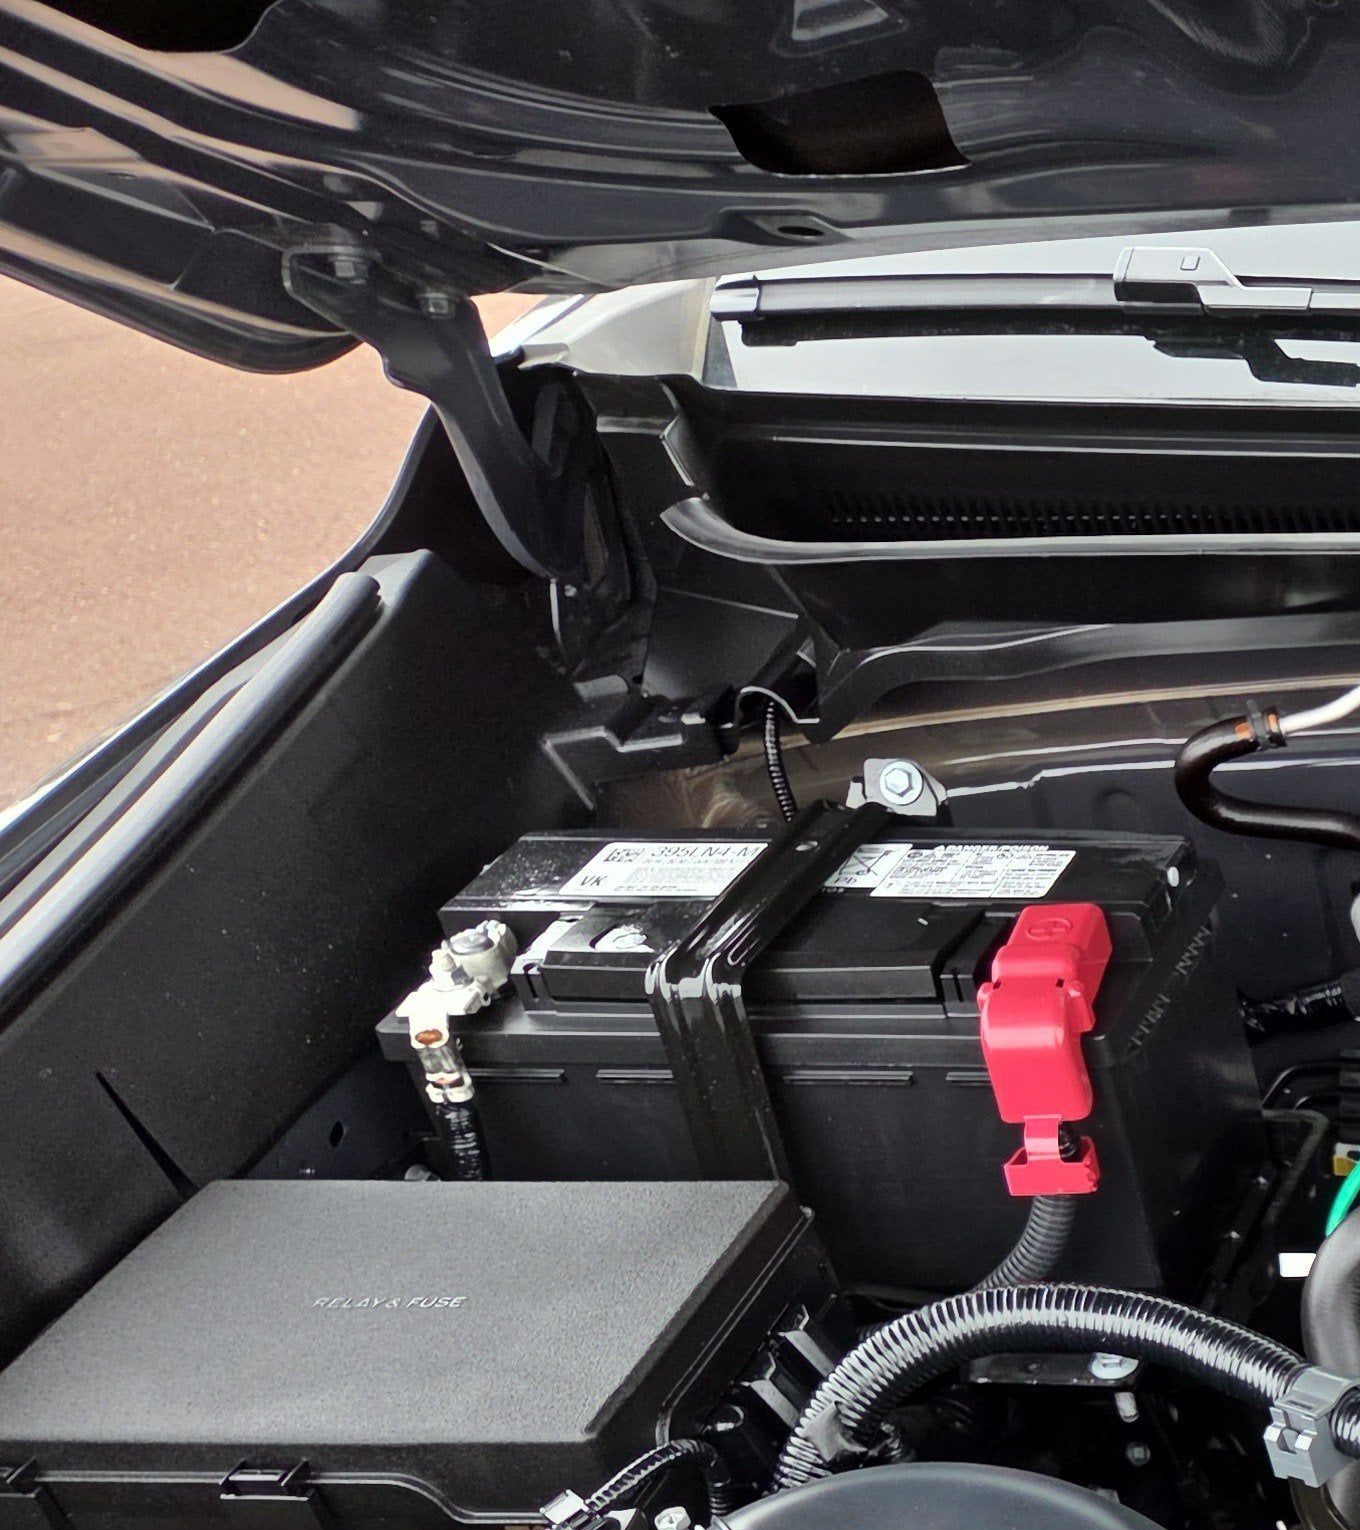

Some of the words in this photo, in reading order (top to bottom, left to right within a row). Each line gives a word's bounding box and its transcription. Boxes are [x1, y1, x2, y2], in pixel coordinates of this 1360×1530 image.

[579, 875, 608, 887] VK
[313, 1296, 386, 1309] RELAY
[386, 1296, 401, 1309] &
[406, 1296, 467, 1309] FUSE
